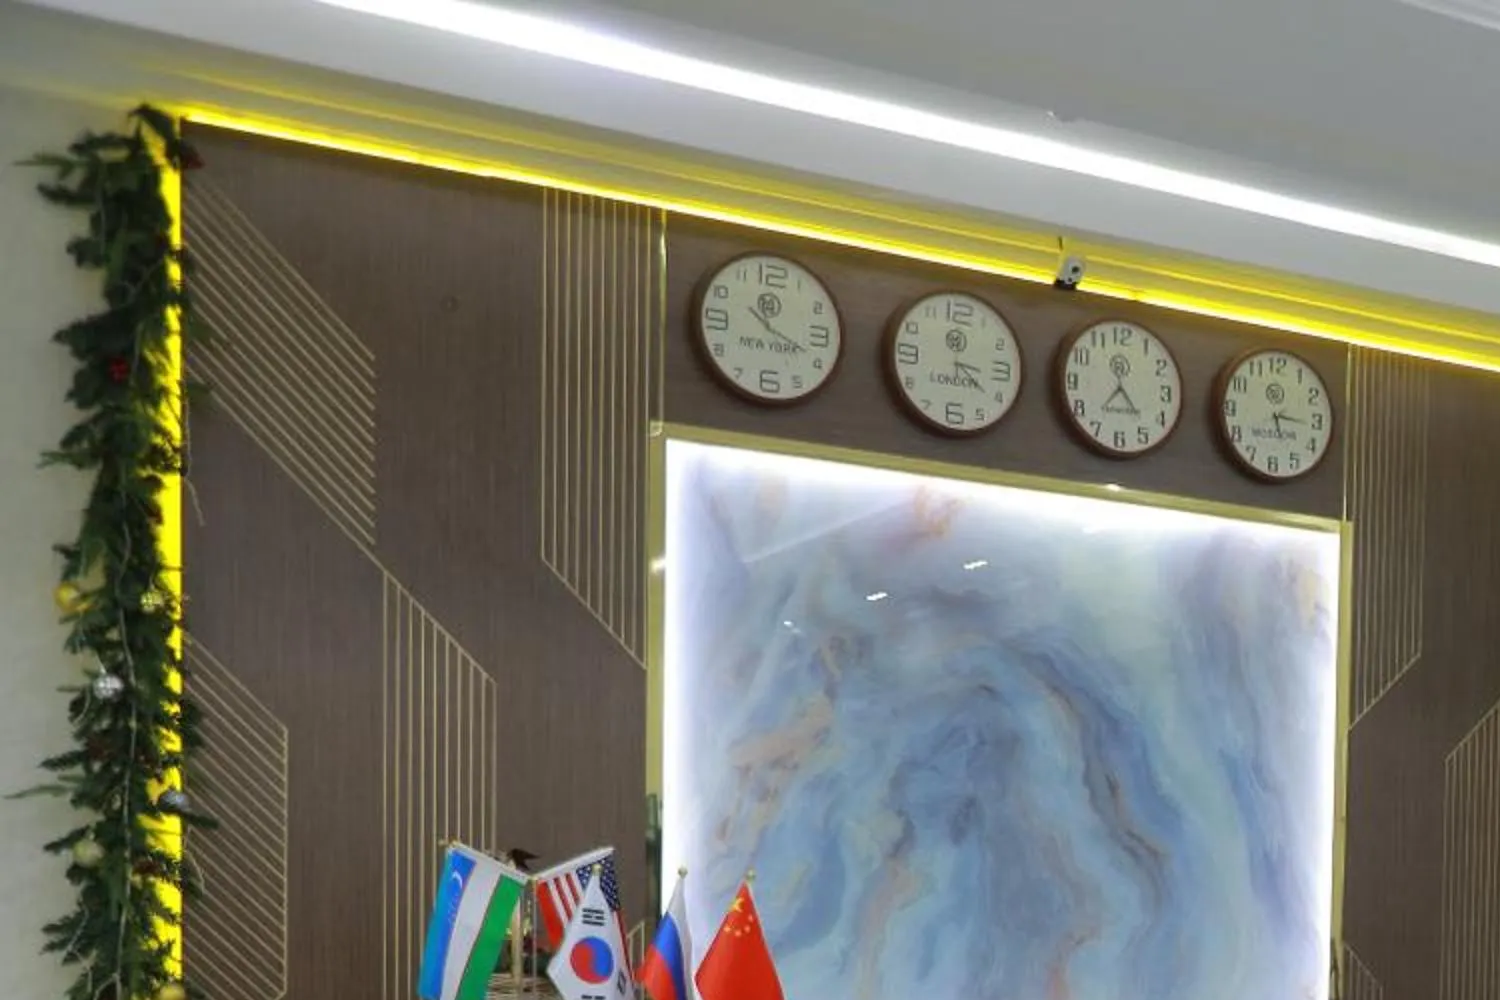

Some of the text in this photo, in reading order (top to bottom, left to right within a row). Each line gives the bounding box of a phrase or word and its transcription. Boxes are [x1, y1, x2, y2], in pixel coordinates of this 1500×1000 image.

[759, 263, 788, 288] 12
[713, 285, 729, 299] 10
[705, 308, 728, 330] 9
[946, 300, 974, 327] 12
[809, 325, 829, 347] 3
[906, 322, 918, 334] 0
[1113, 326, 1133, 346] 12
[739, 336, 765, 349] NEW
[1091, 331, 1105, 348] 11
[1143, 337, 1149, 355] 1
[898, 343, 919, 365] 9
[1074, 345, 1089, 366] 10
[991, 361, 1011, 382] 3
[1155, 358, 1167, 376] 2
[1248, 361, 1263, 378] 11
[1268, 357, 1288, 377] 12
[1297, 367, 1303, 386] 1
[759, 370, 780, 393] 6
[929, 369, 980, 388] LONDON
[1067, 372, 1079, 391] 9
[1232, 375, 1247, 394] 10
[1160, 385, 1172, 403] 3
[1307, 386, 1320, 406] 2
[945, 402, 964, 424] 6
[1073, 399, 1085, 417] 8
[1089, 420, 1102, 438] 7
[1311, 413, 1323, 431] 3
[1113, 431, 1126, 449] 6
[1137, 426, 1149, 445] 5
[1245, 444, 1257, 461] 7
[1304, 437, 1317, 454] 4
[1267, 455, 1279, 473] 6
[1289, 451, 1301, 470] 5
